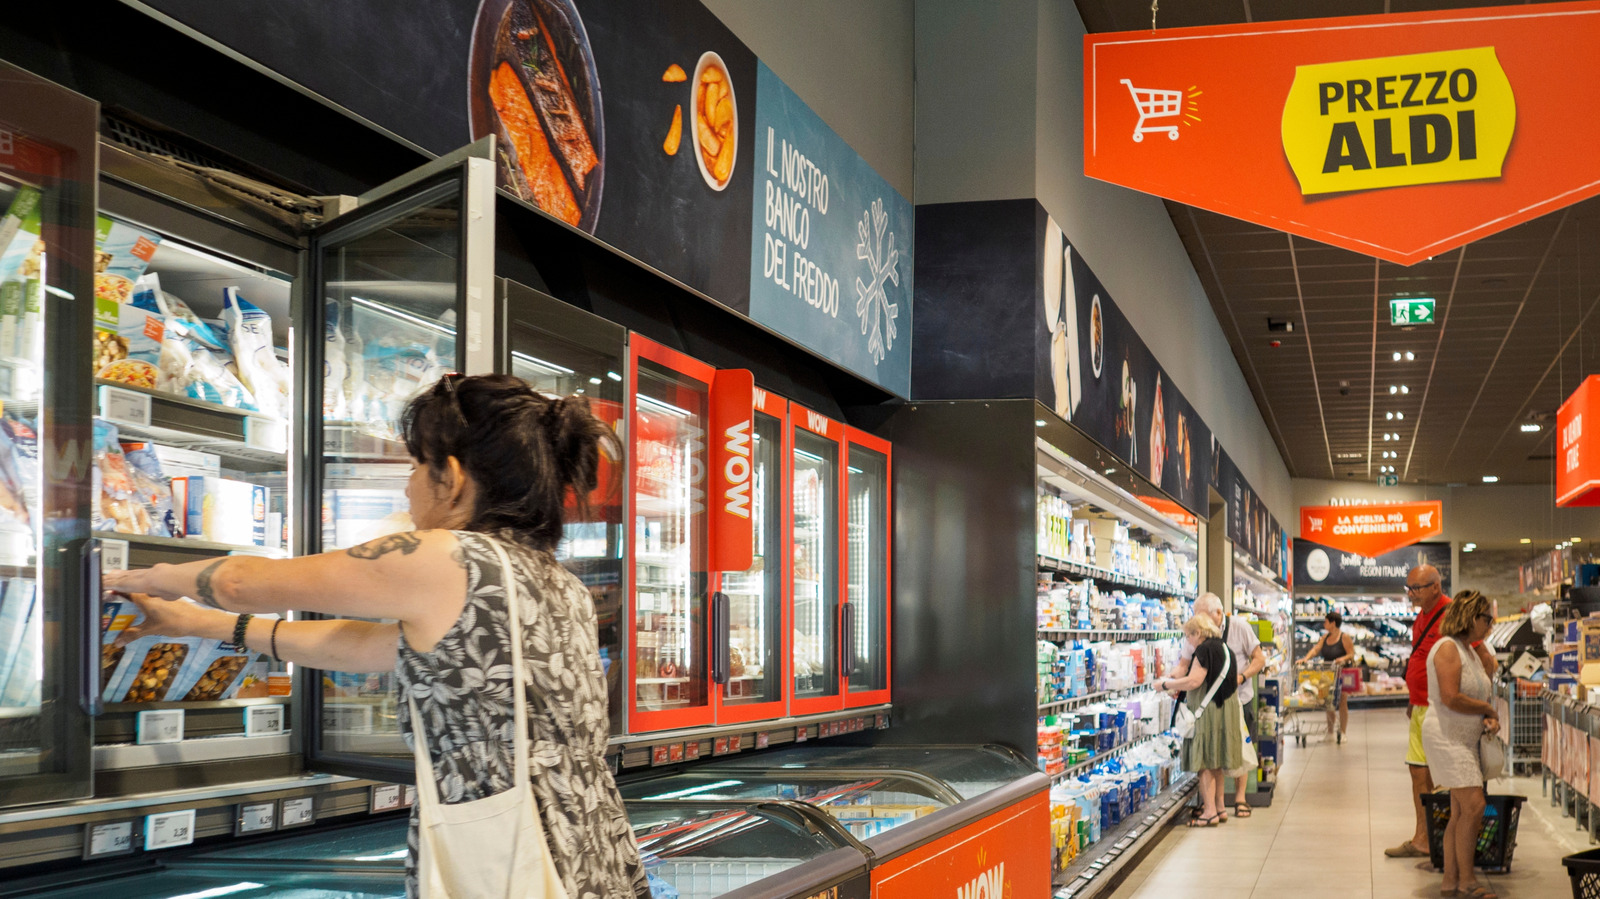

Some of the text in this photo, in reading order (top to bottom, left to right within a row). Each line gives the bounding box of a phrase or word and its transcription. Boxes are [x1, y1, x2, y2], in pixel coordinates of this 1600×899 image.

[1319, 68, 1477, 116] PREZZO
[1322, 109, 1477, 174] ALDI
[766, 126, 829, 215] IL NOSTRO
[765, 179, 810, 250] BANCO
[763, 232, 839, 318] DEL FREDDO
[753, 387, 767, 411] OW
[807, 410, 828, 435] WOW
[724, 419, 750, 519] WOW
[1333, 523, 1408, 535] CONVENIENTE
[1338, 512, 1403, 524] LA SCELTA PIÙ
